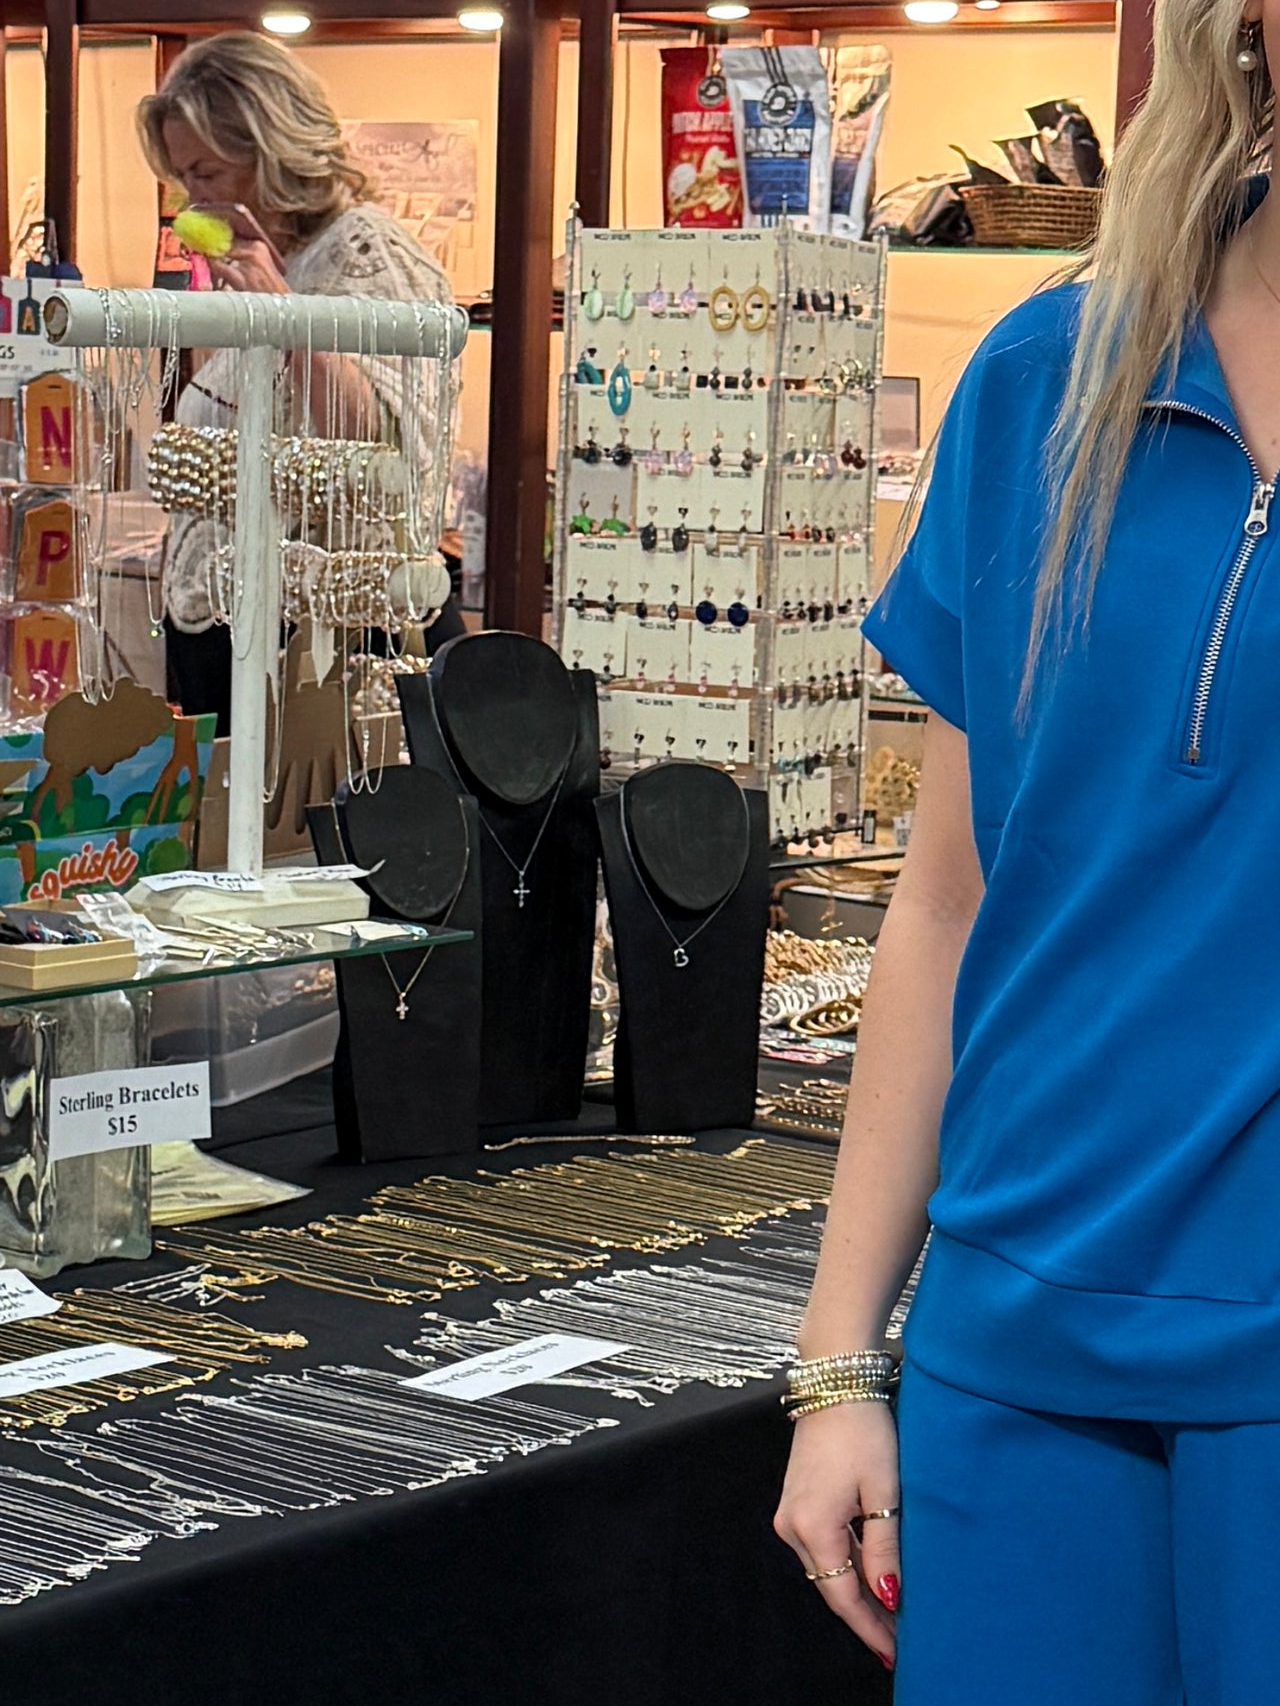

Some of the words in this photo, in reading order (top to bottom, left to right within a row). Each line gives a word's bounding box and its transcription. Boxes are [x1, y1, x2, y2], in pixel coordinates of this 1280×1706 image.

[58, 1091, 115, 1115] Sterling
[119, 1081, 200, 1104] Bracelets
[108, 1114, 138, 1137] $15
